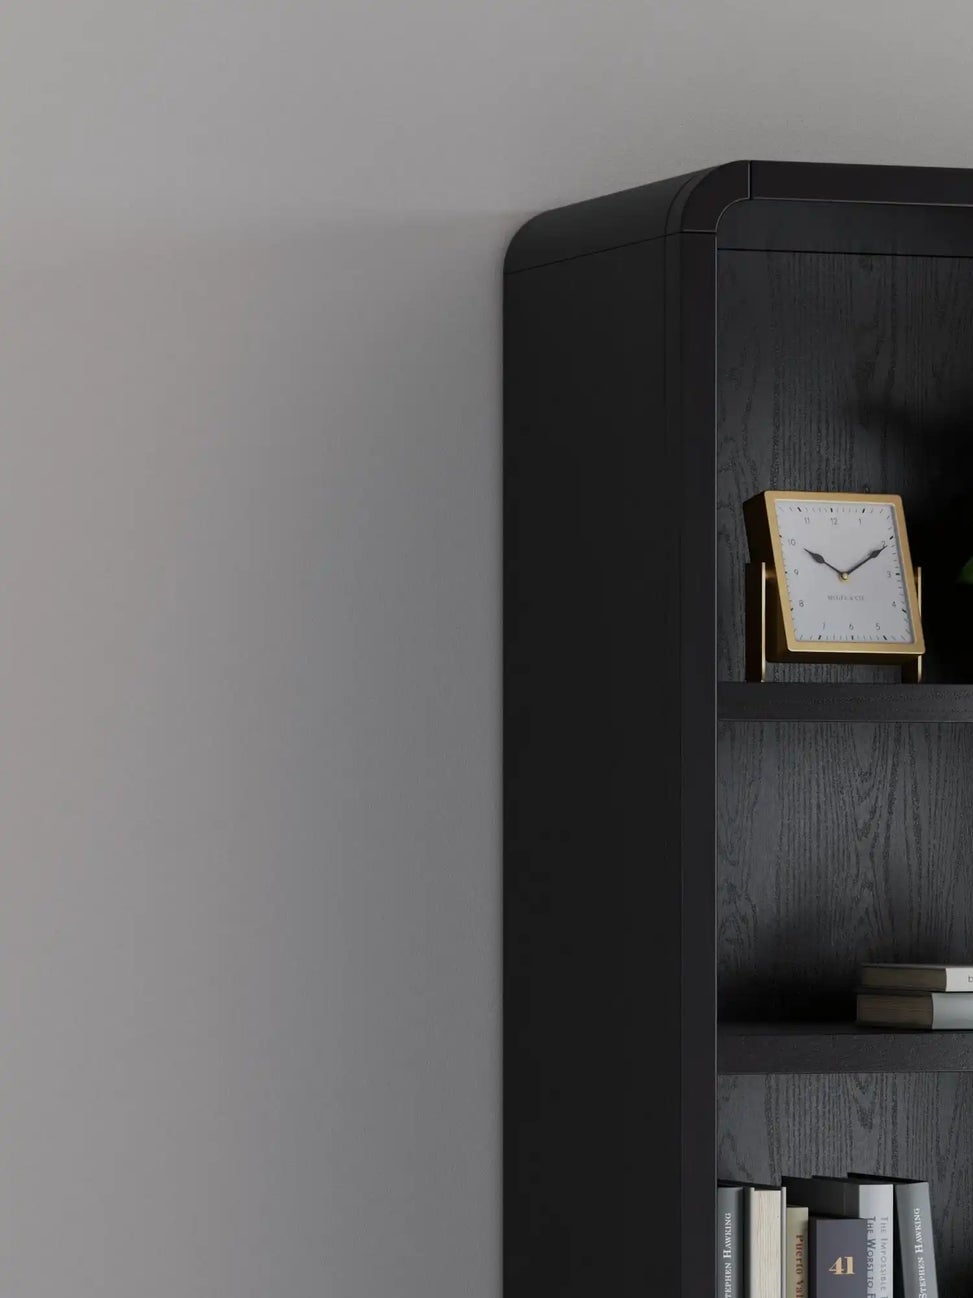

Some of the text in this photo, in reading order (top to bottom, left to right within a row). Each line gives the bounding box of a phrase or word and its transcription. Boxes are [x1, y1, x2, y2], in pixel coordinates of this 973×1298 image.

[804, 516, 810, 524] 11
[831, 517, 838, 526] 12
[787, 538, 796, 546] 10
[795, 1234, 804, 1275] Puerto
[828, 1256, 856, 1275] 41
